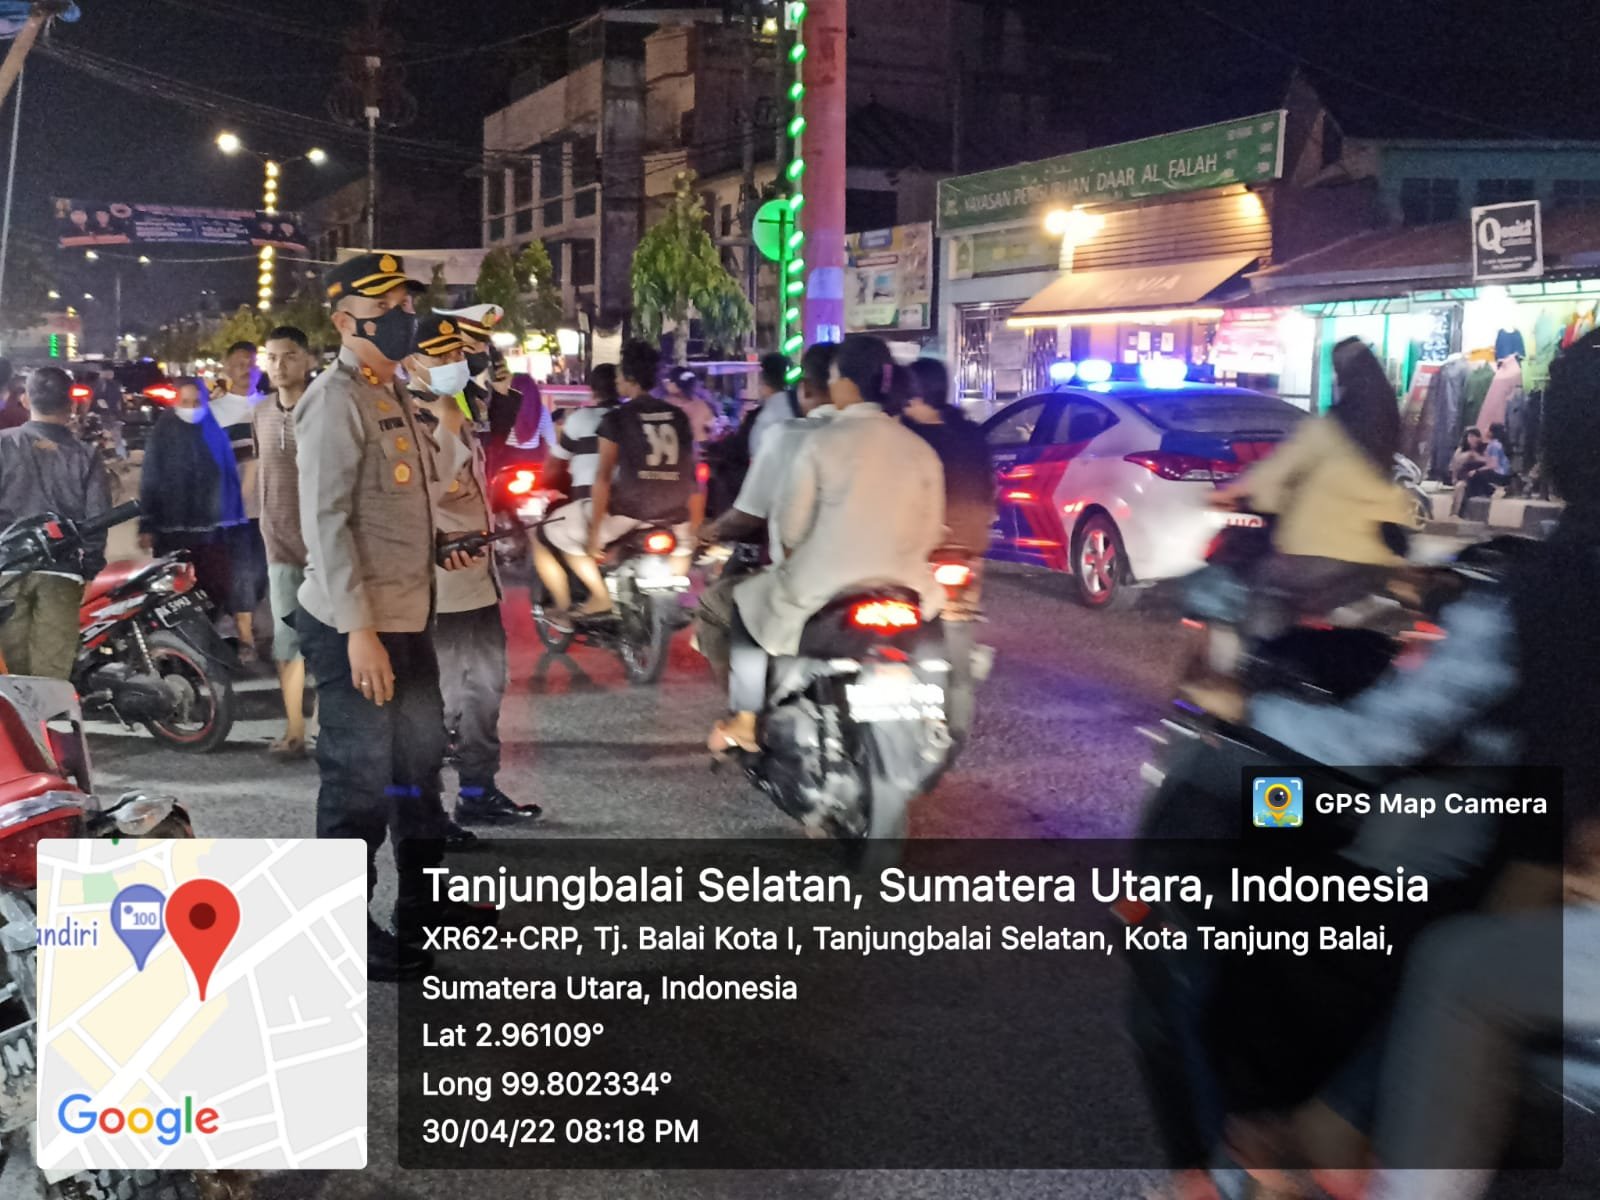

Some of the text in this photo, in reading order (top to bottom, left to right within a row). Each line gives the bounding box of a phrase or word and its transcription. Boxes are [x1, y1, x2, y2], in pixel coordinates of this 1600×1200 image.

[1096, 167, 1135, 191] DAAR
[1141, 164, 1162, 184] AL
[1168, 153, 1217, 179] FALAH
